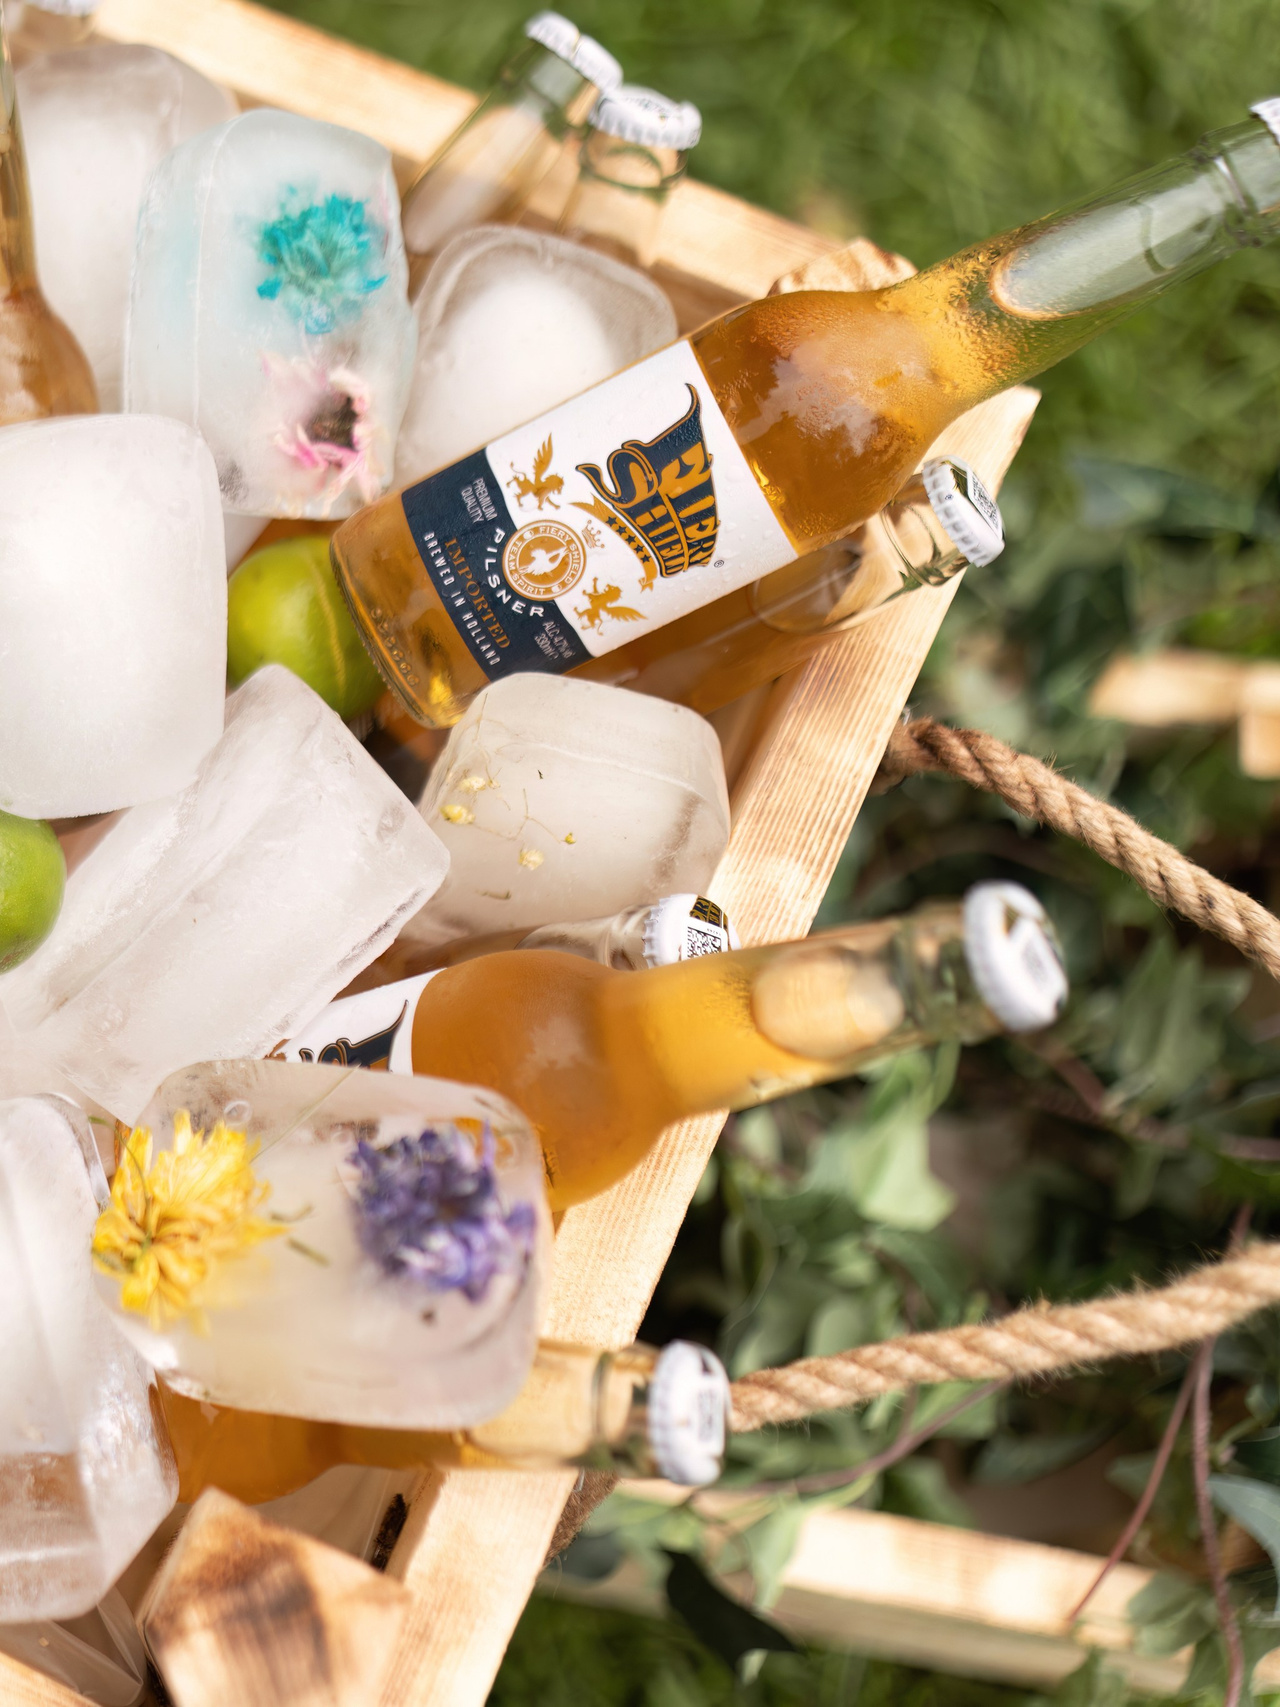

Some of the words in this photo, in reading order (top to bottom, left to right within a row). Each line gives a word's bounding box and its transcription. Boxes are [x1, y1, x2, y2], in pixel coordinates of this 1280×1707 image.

[461, 486, 484, 523] QUALITY
[472, 477, 498, 521] PREMIUM
[485, 528, 544, 617] PILSNER
[508, 540, 523, 570] TEAM
[539, 526, 571, 542] FIERY
[564, 543, 580, 584] SHIELD
[424, 531, 455, 586] BREWED
[451, 591, 465, 607] IN
[462, 613, 501, 666] HOLLAND
[444, 537, 511, 649] IMPORTED
[512, 573, 546, 595] SPIRIT
